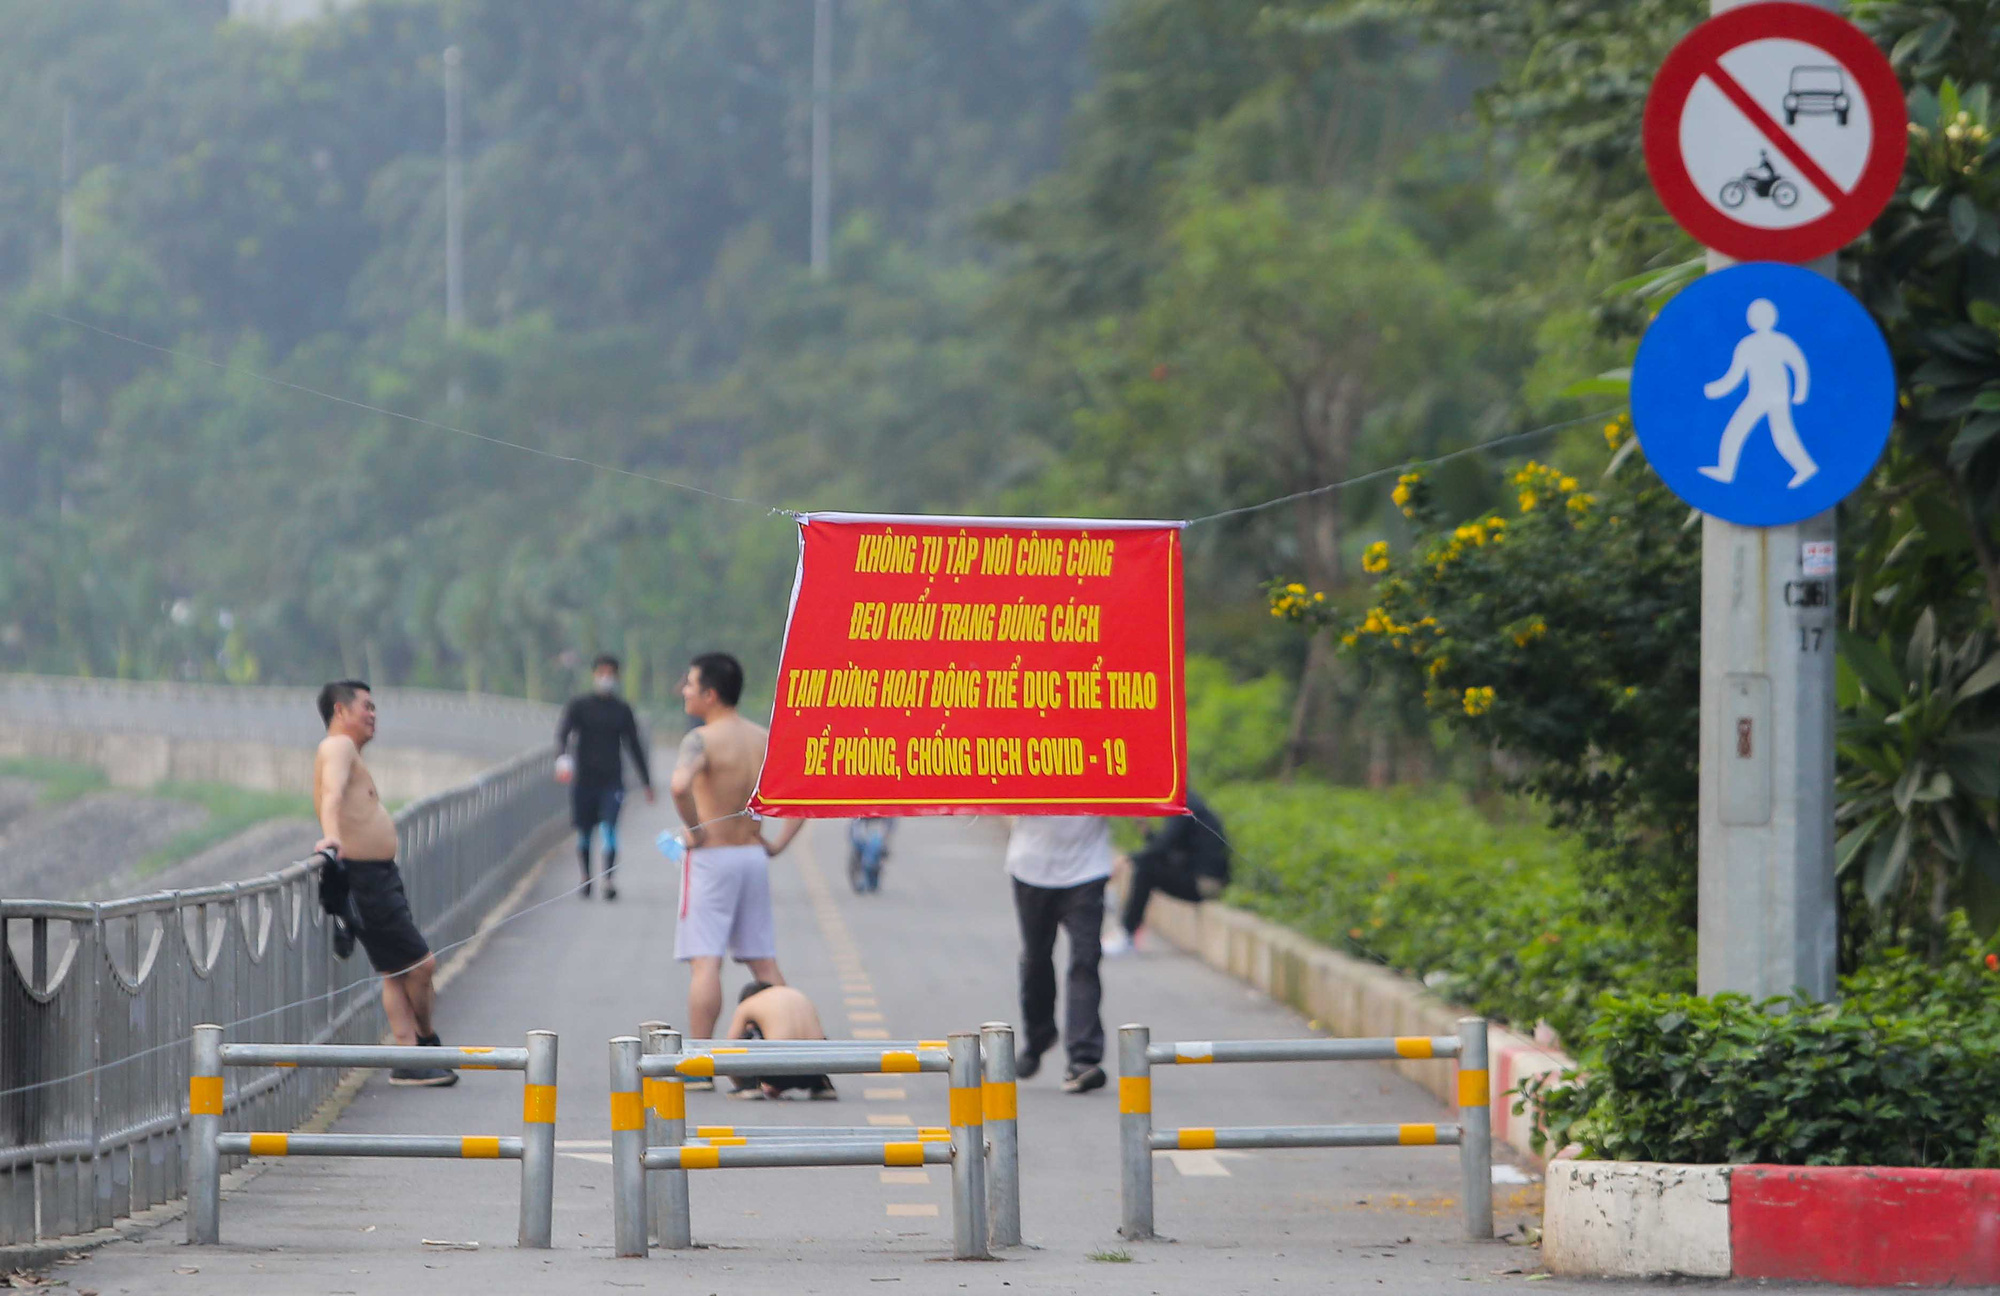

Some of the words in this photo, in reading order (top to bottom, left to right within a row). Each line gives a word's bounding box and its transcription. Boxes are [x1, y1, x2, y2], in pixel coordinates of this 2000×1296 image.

[854, 527, 918, 574] KHÔNG
[919, 535, 944, 584] TỤ
[945, 528, 980, 584] TẬP
[980, 533, 1014, 576] NƠI
[1015, 527, 1064, 577] CÔNG
[1065, 530, 1115, 585] CỘNG
[847, 601, 887, 641] ĐEO
[886, 586, 938, 642] KHẨU
[938, 602, 997, 642] TRANG
[996, 595, 1048, 643] ĐÚNG
[1050, 596, 1101, 643] CÁCH
[1800, 627, 1823, 652] 17
[786, 668, 828, 717] TẠM
[825, 660, 879, 709] DỪNG
[879, 669, 930, 717] HOẠT
[929, 661, 982, 718] ĐỘNG
[985, 654, 1022, 709] THỂ
[1023, 670, 1062, 718] DỤC
[1065, 655, 1104, 710] THỂ
[1106, 671, 1158, 710] THAO
[803, 723, 832, 776] ĐỀ
[832, 727, 902, 781] PHÒNG,
[906, 723, 972, 777] CHỐNG
[976, 737, 1023, 785] DỊCH
[1026, 736, 1085, 777] COVID
[1102, 737, 1128, 776] 19
